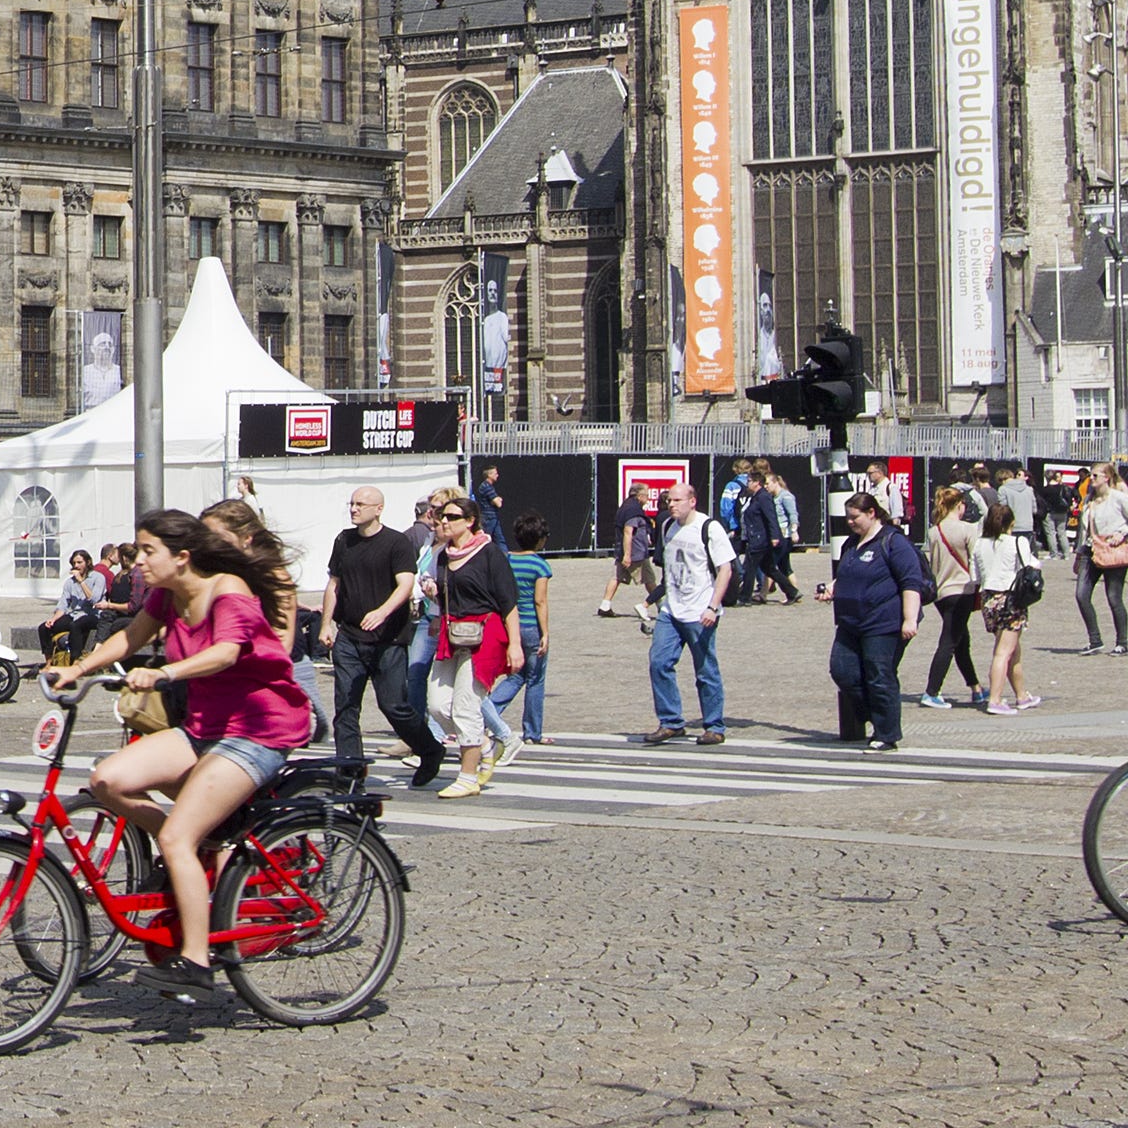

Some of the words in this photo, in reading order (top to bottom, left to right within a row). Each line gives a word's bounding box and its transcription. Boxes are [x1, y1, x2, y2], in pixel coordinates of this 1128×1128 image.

[983, 227, 994, 242] de
[970, 239, 981, 255] De
[957, 229, 969, 297] Amsterdam
[983, 244, 997, 290] Oranjes
[971, 257, 982, 301] Nieuwe
[973, 303, 985, 330] Kerk
[363, 410, 396, 430] DUTCH
[399, 410, 412, 421] LIFE
[363, 431, 395, 449] STREET
[396, 431, 414, 448] CUP
